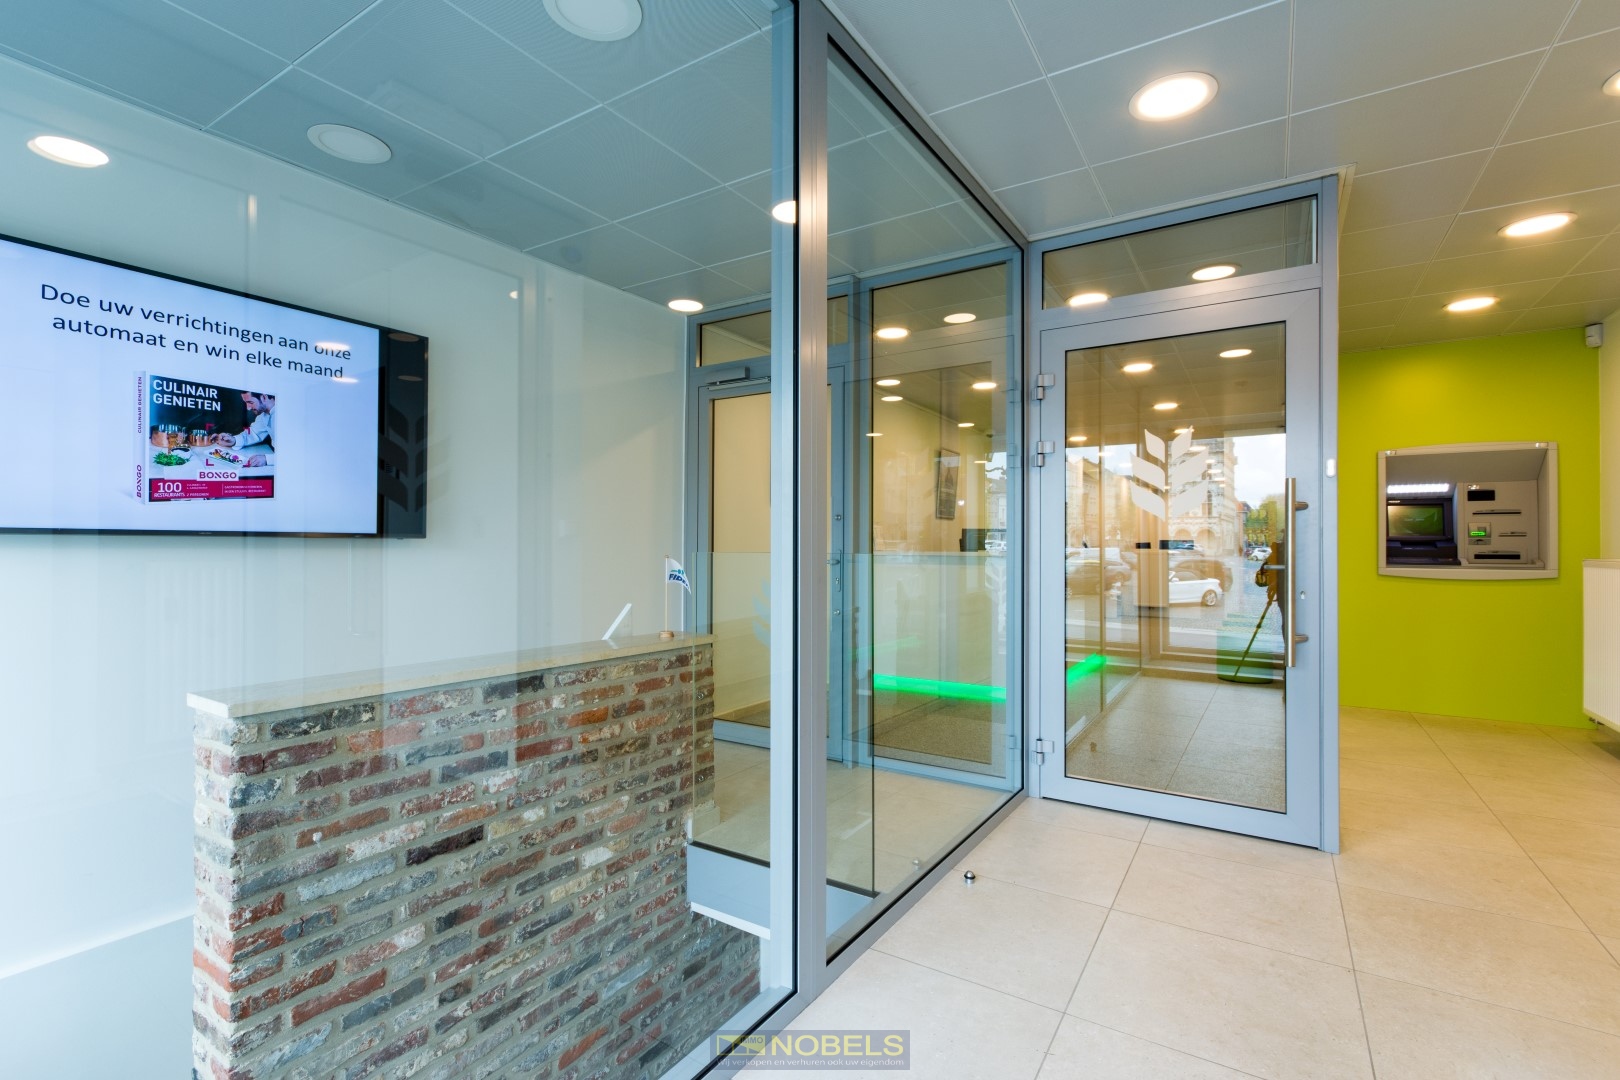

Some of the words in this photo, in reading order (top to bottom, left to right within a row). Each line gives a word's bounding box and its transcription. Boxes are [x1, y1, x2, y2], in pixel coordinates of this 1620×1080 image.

[41, 283, 90, 308] Doe
[99, 299, 134, 316] uw
[140, 307, 273, 345] verrichtingen
[278, 336, 309, 351] aan
[314, 344, 351, 360] onze
[52, 316, 166, 348] automaat
[173, 339, 198, 354] en
[205, 344, 240, 361] win
[246, 350, 282, 368] elke
[288, 359, 343, 379] maand
[153, 379, 218, 400] CULINAIR
[153, 393, 221, 412] GENIETEN
[199, 471, 238, 479] BONGO
[157, 482, 182, 493] 100
